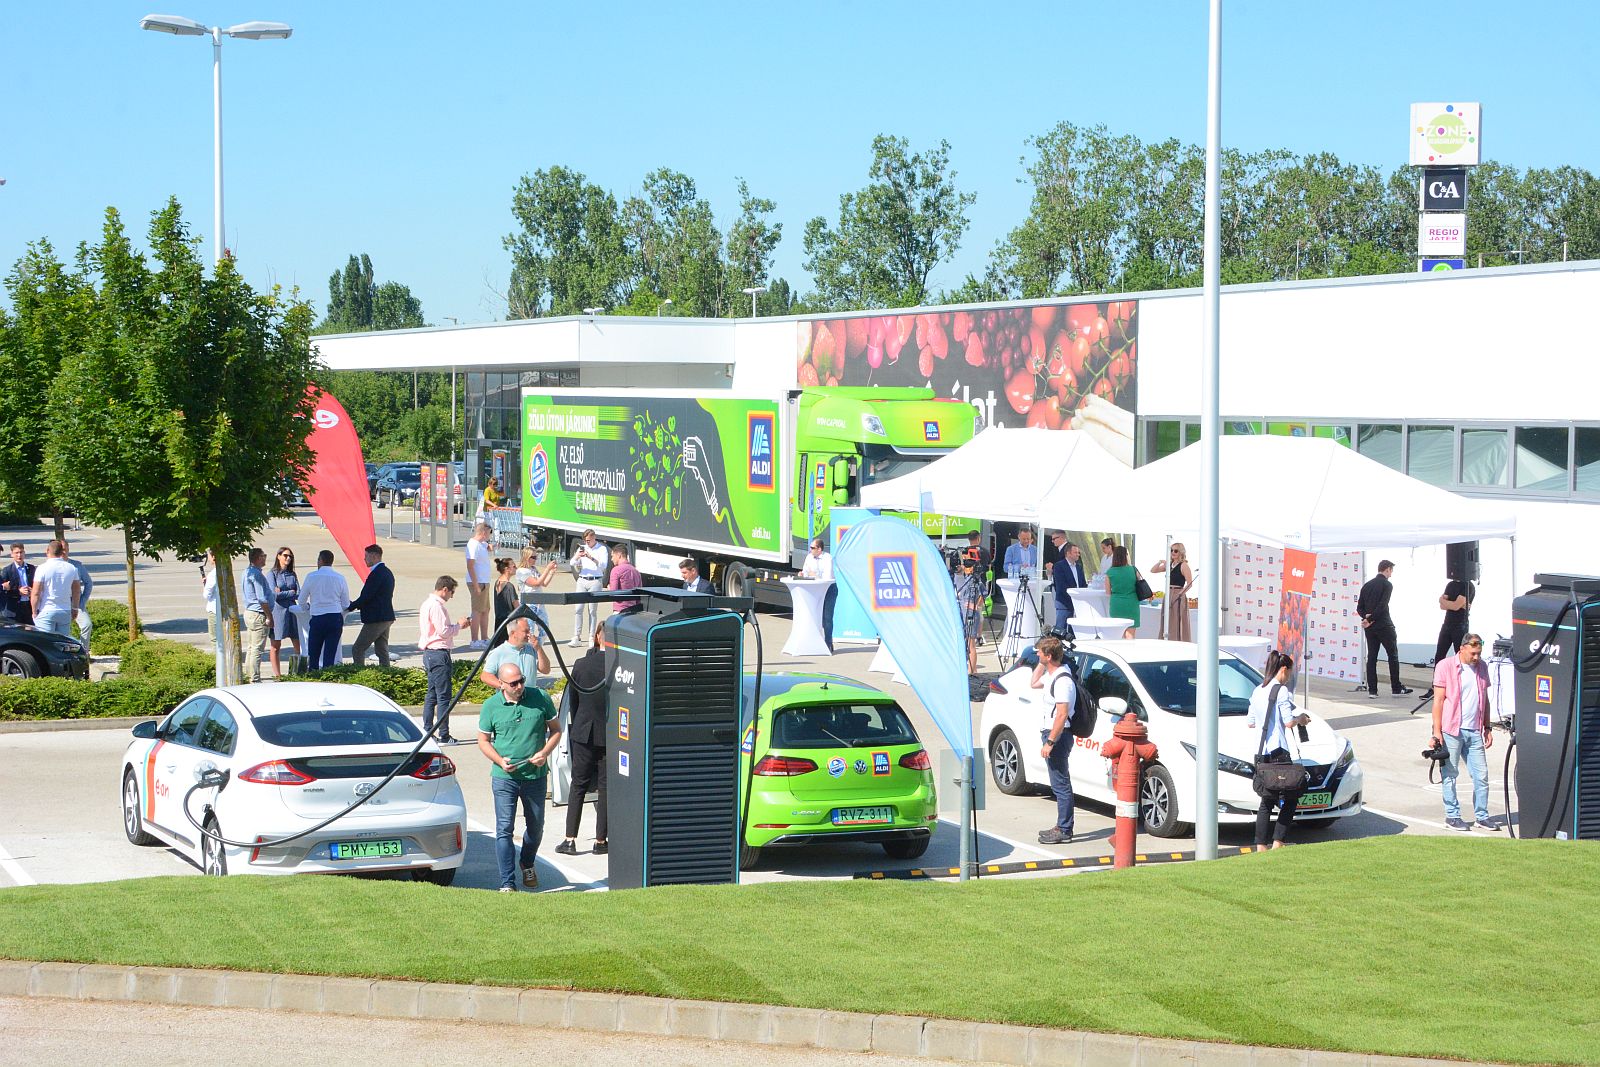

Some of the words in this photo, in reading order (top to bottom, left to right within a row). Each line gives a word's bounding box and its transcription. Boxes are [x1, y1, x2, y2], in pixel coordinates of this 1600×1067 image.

[1426, 125, 1467, 137] ZONE
[1429, 182, 1460, 198] C&A
[528, 408, 545, 431] ZÖLD
[547, 408, 564, 431] ÚTON
[565, 408, 596, 435] JÁRUNK!
[560, 445, 568, 463] AZ
[752, 461, 771, 475] ALDI
[565, 464, 626, 491] ÉLELMISZERSZÁLLÍTÓ
[576, 491, 606, 512] E-KAMION
[752, 527, 771, 540] aldi.hu
[840, 807, 889, 820] RVZ-311
[341, 841, 399, 857] PMY-153
